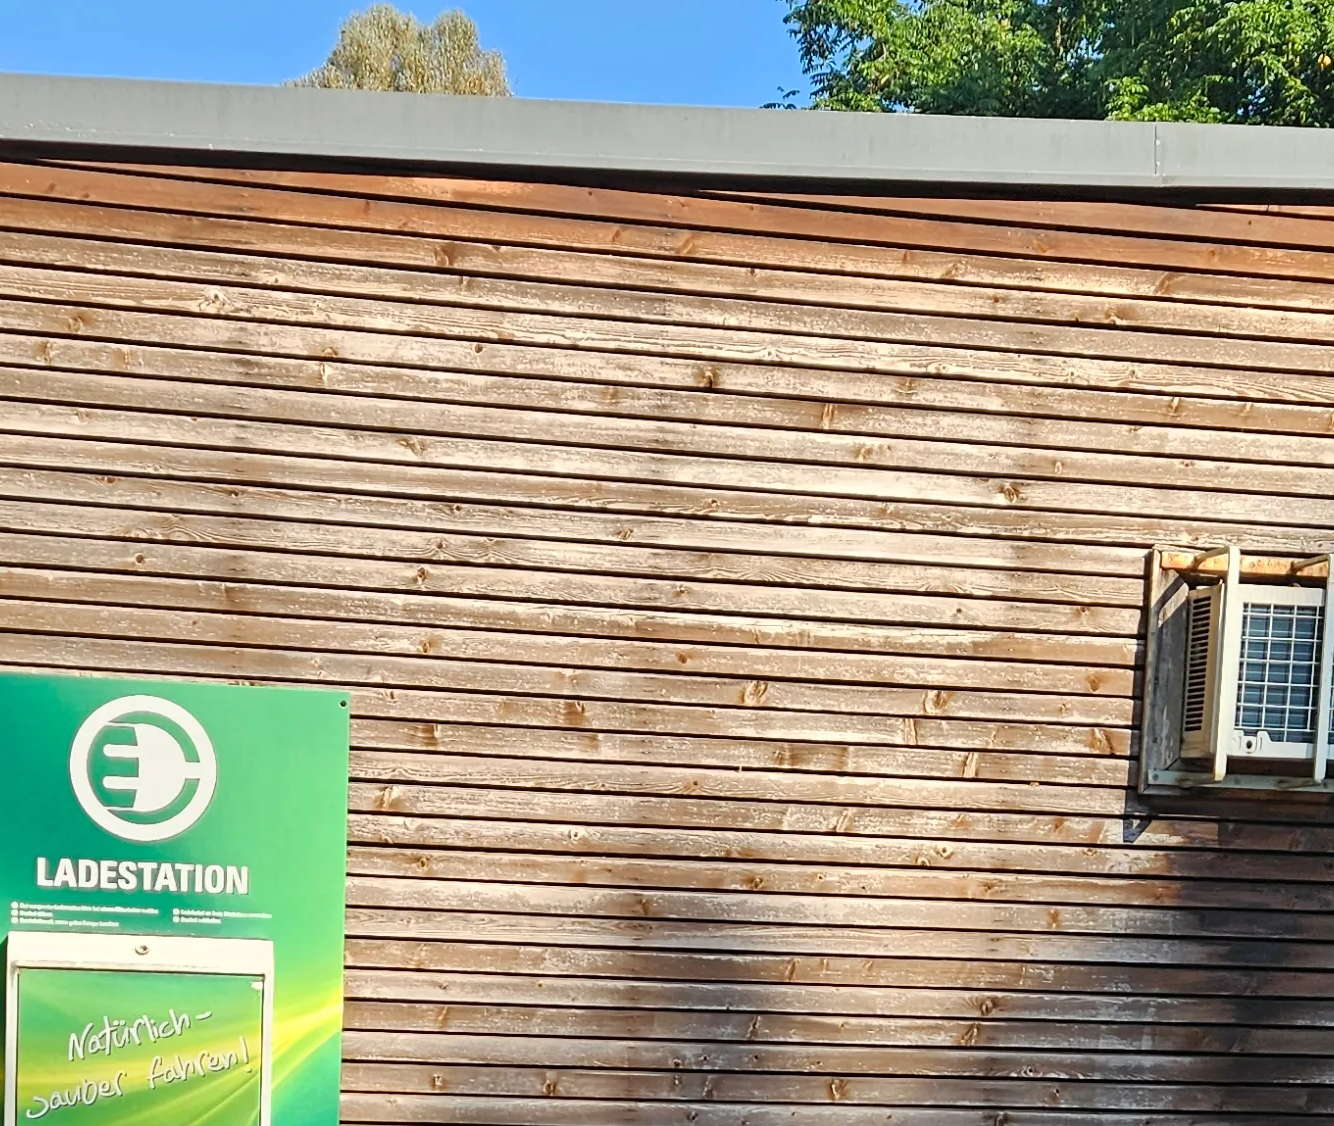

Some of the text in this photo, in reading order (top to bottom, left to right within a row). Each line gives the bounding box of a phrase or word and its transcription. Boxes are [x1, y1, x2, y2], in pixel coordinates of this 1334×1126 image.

[37, 856, 250, 895] LADESTATION
[26, 1035, 253, 1119] sauber fahren!
